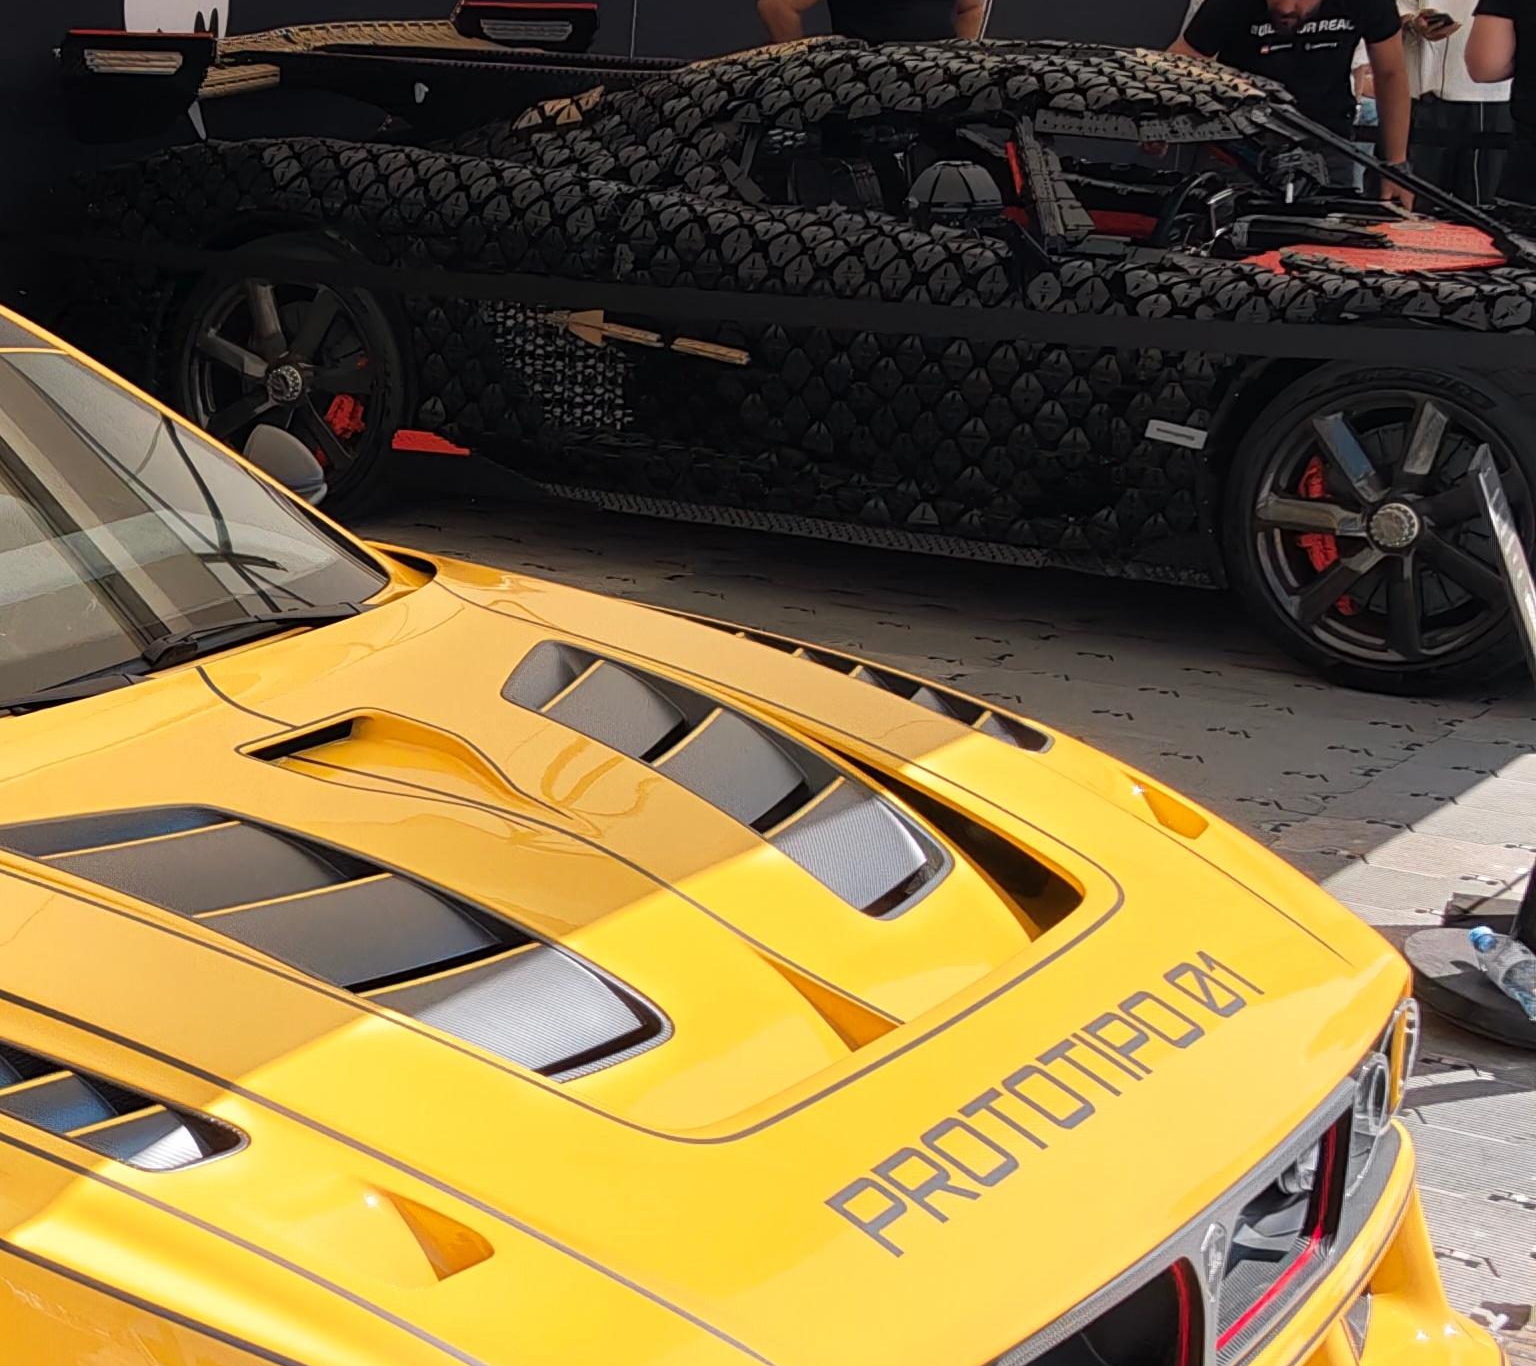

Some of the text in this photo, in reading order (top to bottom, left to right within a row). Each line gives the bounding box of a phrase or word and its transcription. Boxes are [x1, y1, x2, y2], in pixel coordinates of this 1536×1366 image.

[1250, 23, 1276, 37] BUIL
[1318, 18, 1354, 32] REAL
[824, 950, 1266, 1258] PROTOTIPO 01
